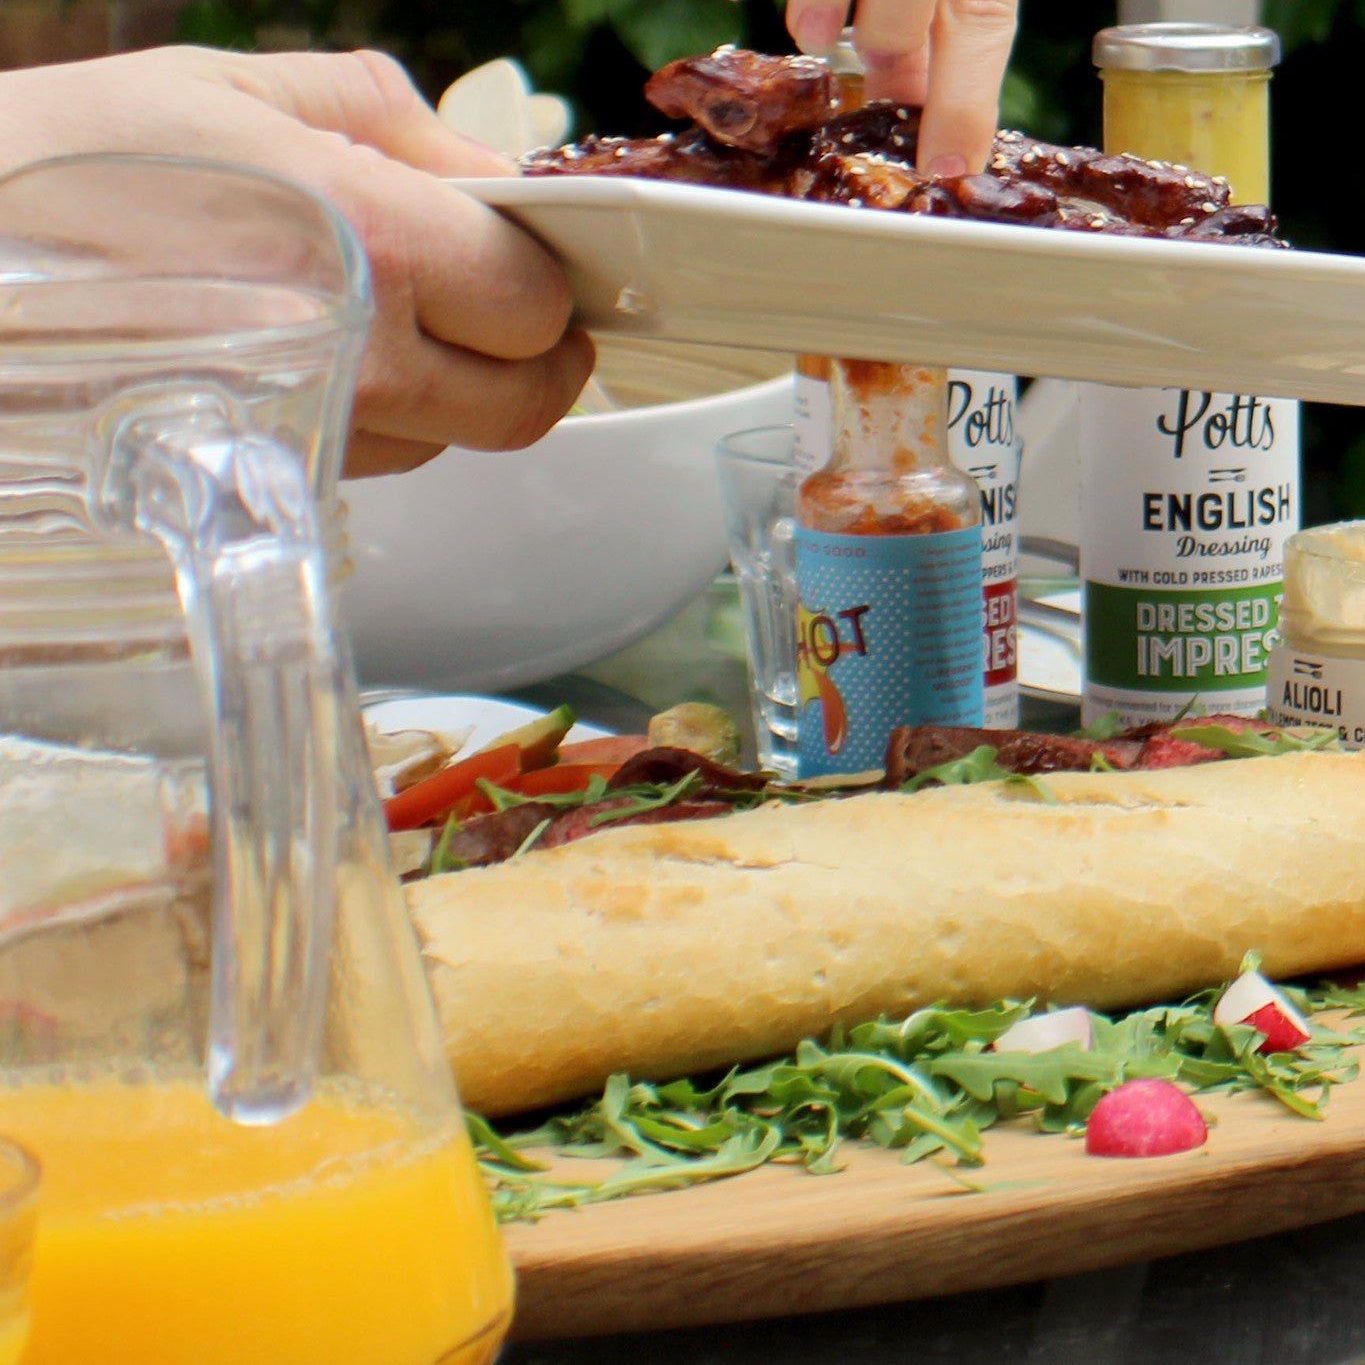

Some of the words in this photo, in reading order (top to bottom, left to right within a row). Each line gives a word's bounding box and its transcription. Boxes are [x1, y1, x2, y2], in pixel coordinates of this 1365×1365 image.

[1142, 483, 1291, 531] ENGLISH
[1176, 536, 1272, 560] Dressing
[1118, 567, 1149, 583] WITH
[1153, 571, 1188, 585] COLD
[1193, 569, 1249, 584] PRESSED
[1137, 597, 1269, 633] DRESSED
[1283, 680, 1342, 716] ALIOLI
